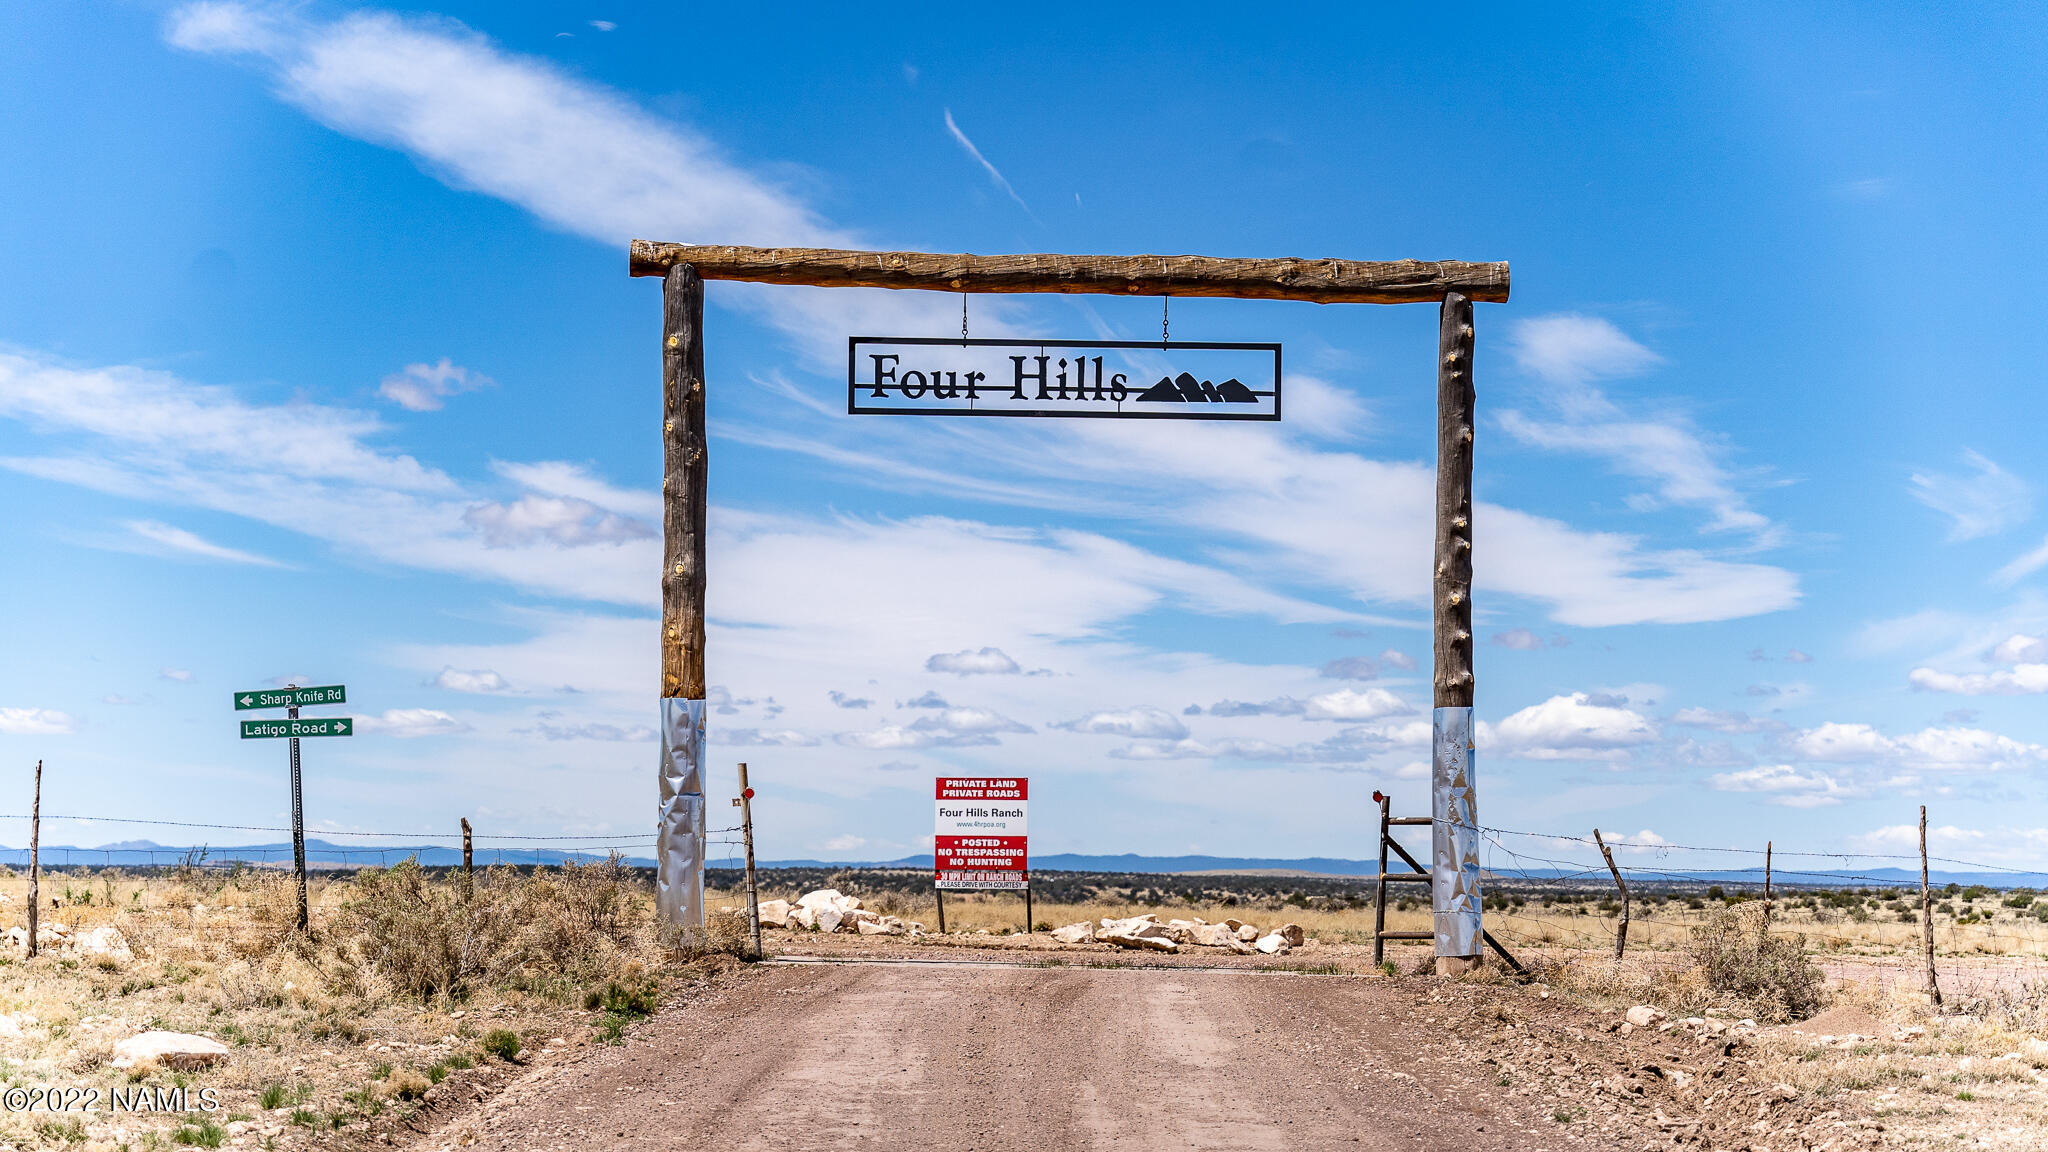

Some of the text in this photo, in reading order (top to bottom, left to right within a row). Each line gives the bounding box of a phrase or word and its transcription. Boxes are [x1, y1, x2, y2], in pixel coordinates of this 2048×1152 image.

[869, 354, 1128, 402] Four Hills
[260, 689, 341, 705] Sharp Knife Rd
[245, 722, 327, 736] Latigo Road
[946, 780, 1017, 788] PRIVATE LAND
[942, 790, 1020, 798] PRIVATE ROADS
[939, 808, 1023, 818] Four Hills Ranch
[961, 839, 1000, 847] POSTED
[938, 848, 1024, 857] NO TRESPASSING
[949, 858, 1013, 866] NO HUNTING
[993, 881, 1023, 889] COURTESY
